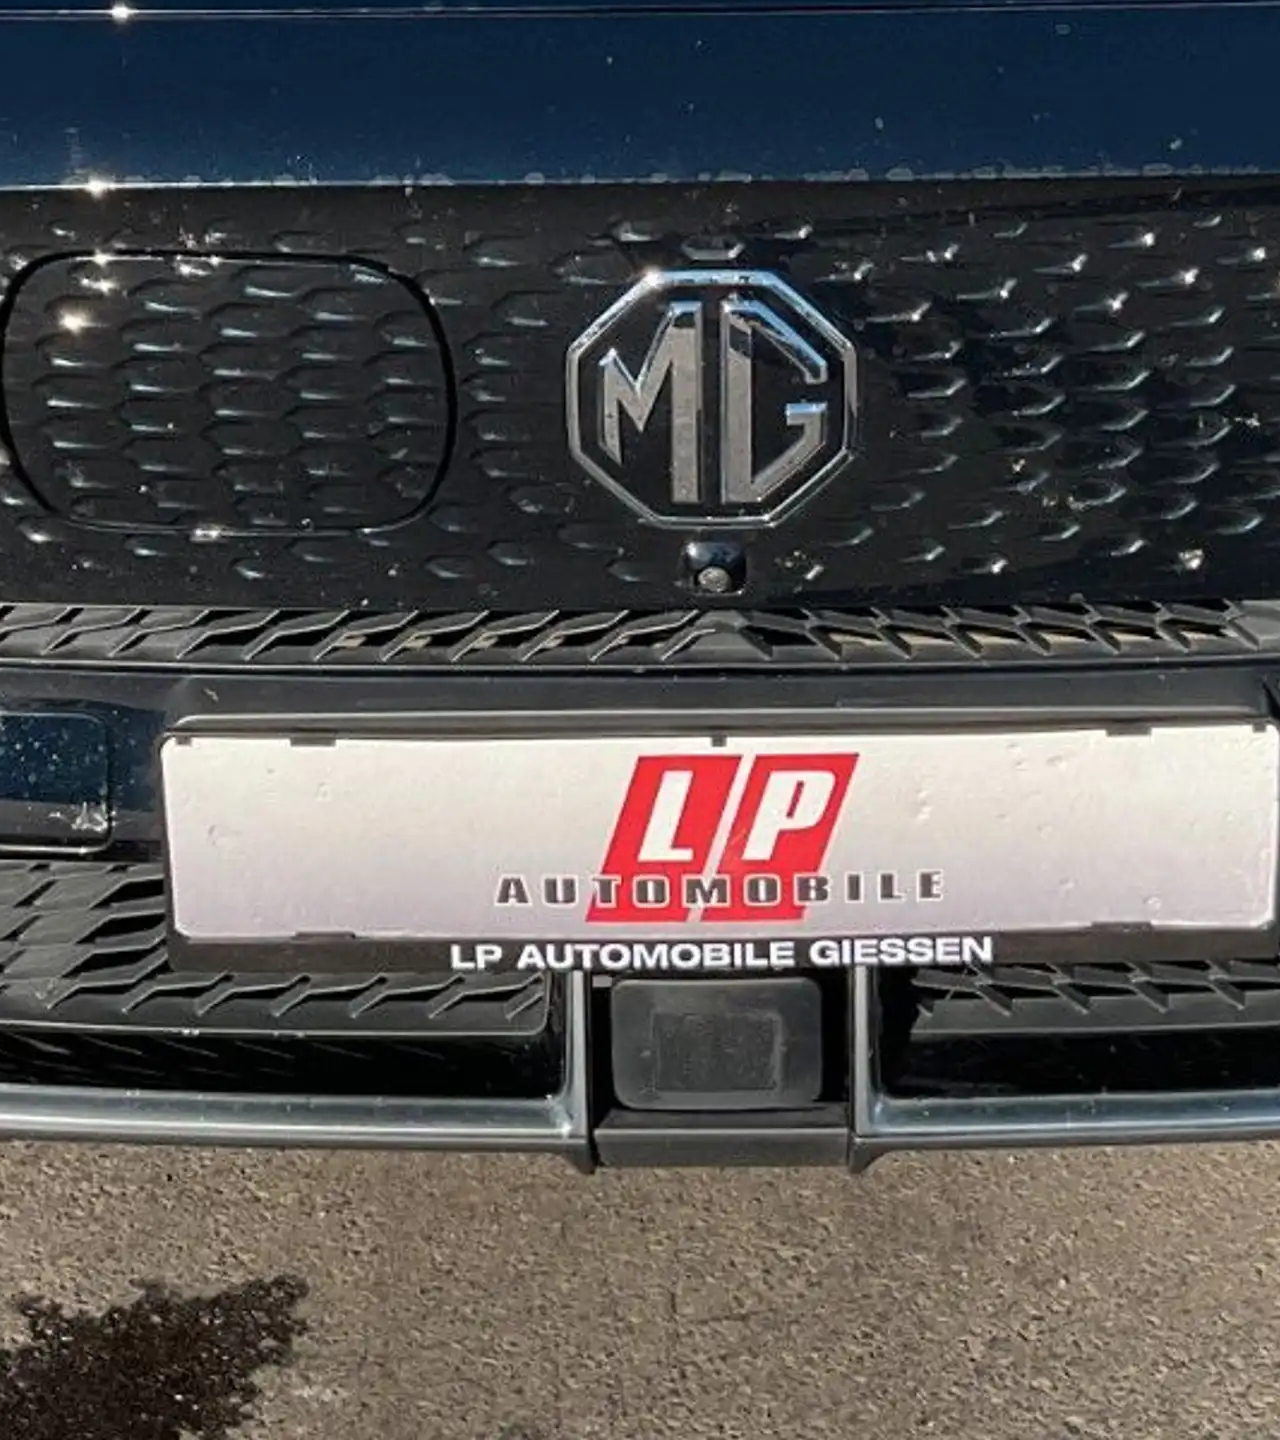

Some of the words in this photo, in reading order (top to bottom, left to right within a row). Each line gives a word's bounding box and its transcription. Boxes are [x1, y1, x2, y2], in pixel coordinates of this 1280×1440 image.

[596, 300, 828, 505] MG
[638, 769, 836, 863] LP
[495, 870, 944, 908] AUTOMOBILE
[450, 943, 503, 971] LP
[517, 940, 796, 969] AUTOMOBILE
[809, 936, 994, 965] GIESSEN
